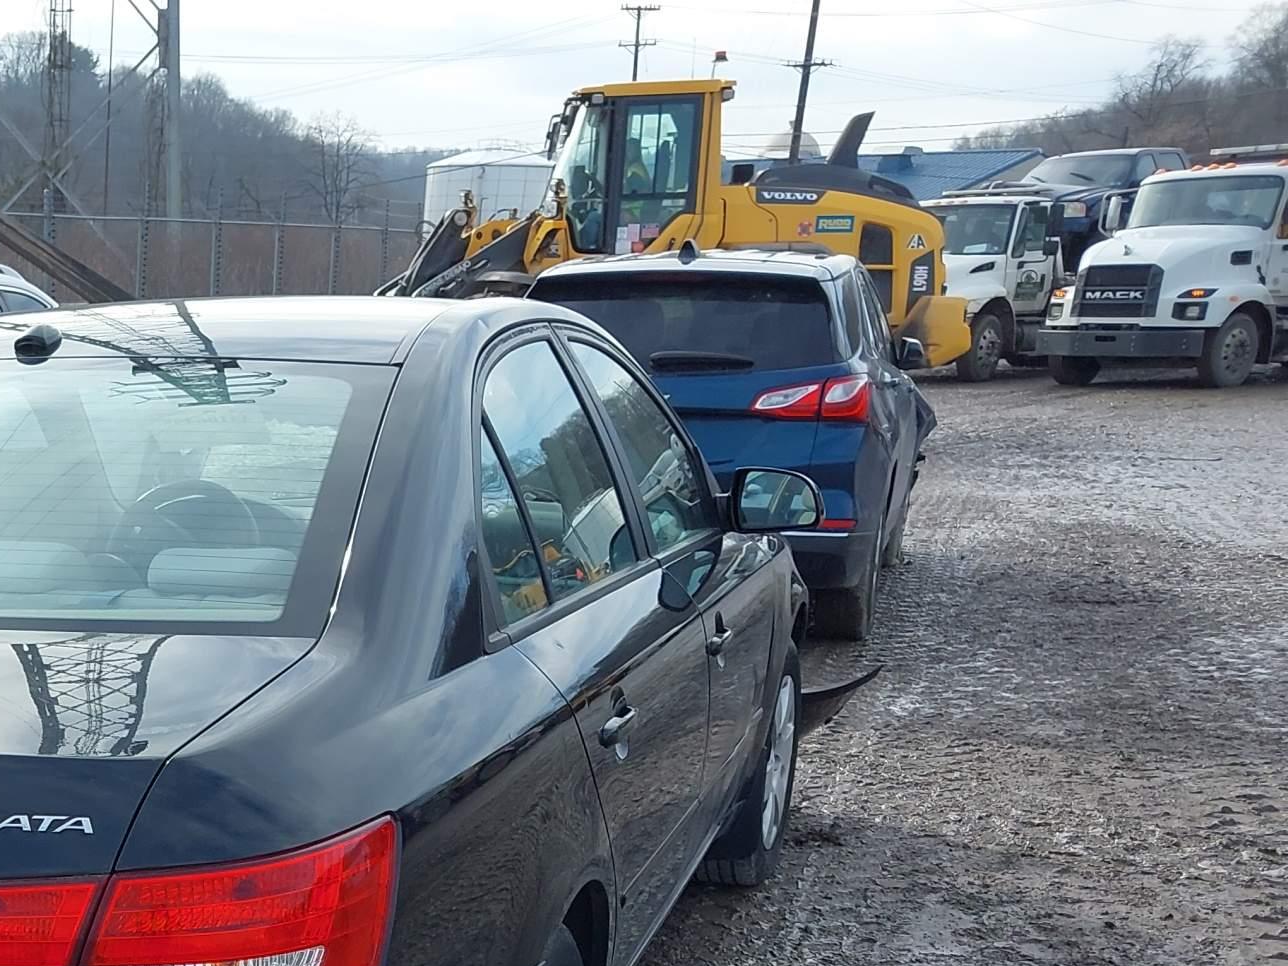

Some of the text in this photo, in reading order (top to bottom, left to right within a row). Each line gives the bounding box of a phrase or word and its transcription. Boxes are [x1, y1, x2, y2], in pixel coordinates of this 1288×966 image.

[761, 191, 818, 201] VOLVO
[912, 265, 929, 292] L90H
[1084, 290, 1144, 300] MACK
